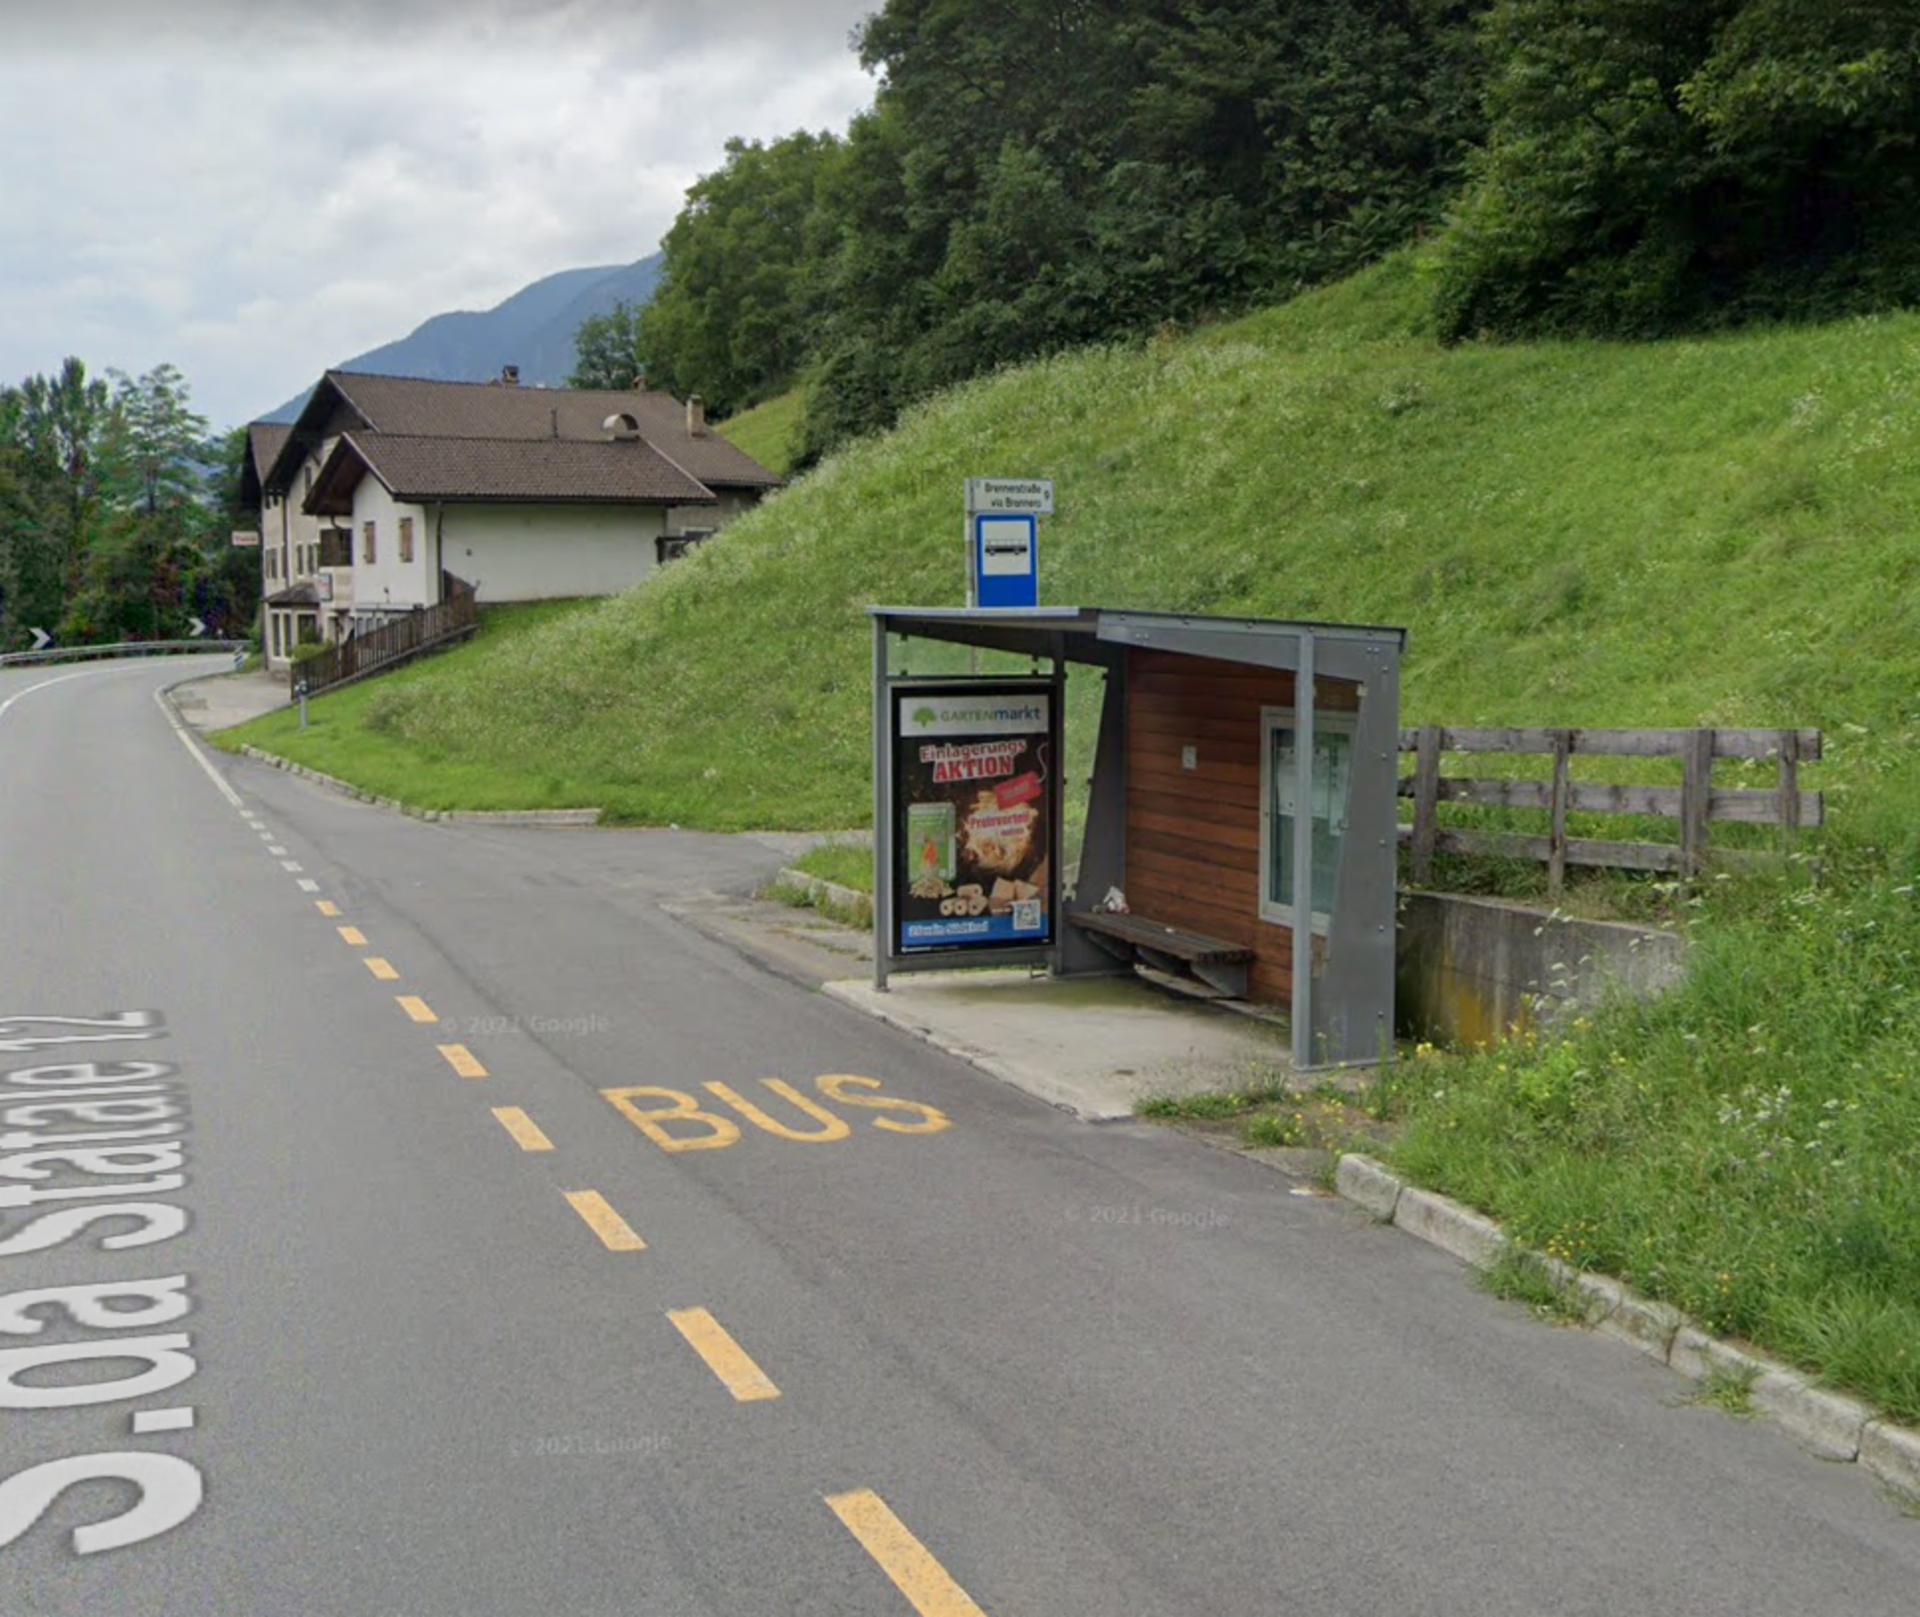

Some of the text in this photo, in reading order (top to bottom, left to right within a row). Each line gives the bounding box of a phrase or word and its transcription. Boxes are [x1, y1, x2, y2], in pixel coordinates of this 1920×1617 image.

[920, 741, 1026, 761] Einlagerungs
[935, 756, 1013, 780] AKTION
[600, 1073, 954, 1153] BUS
